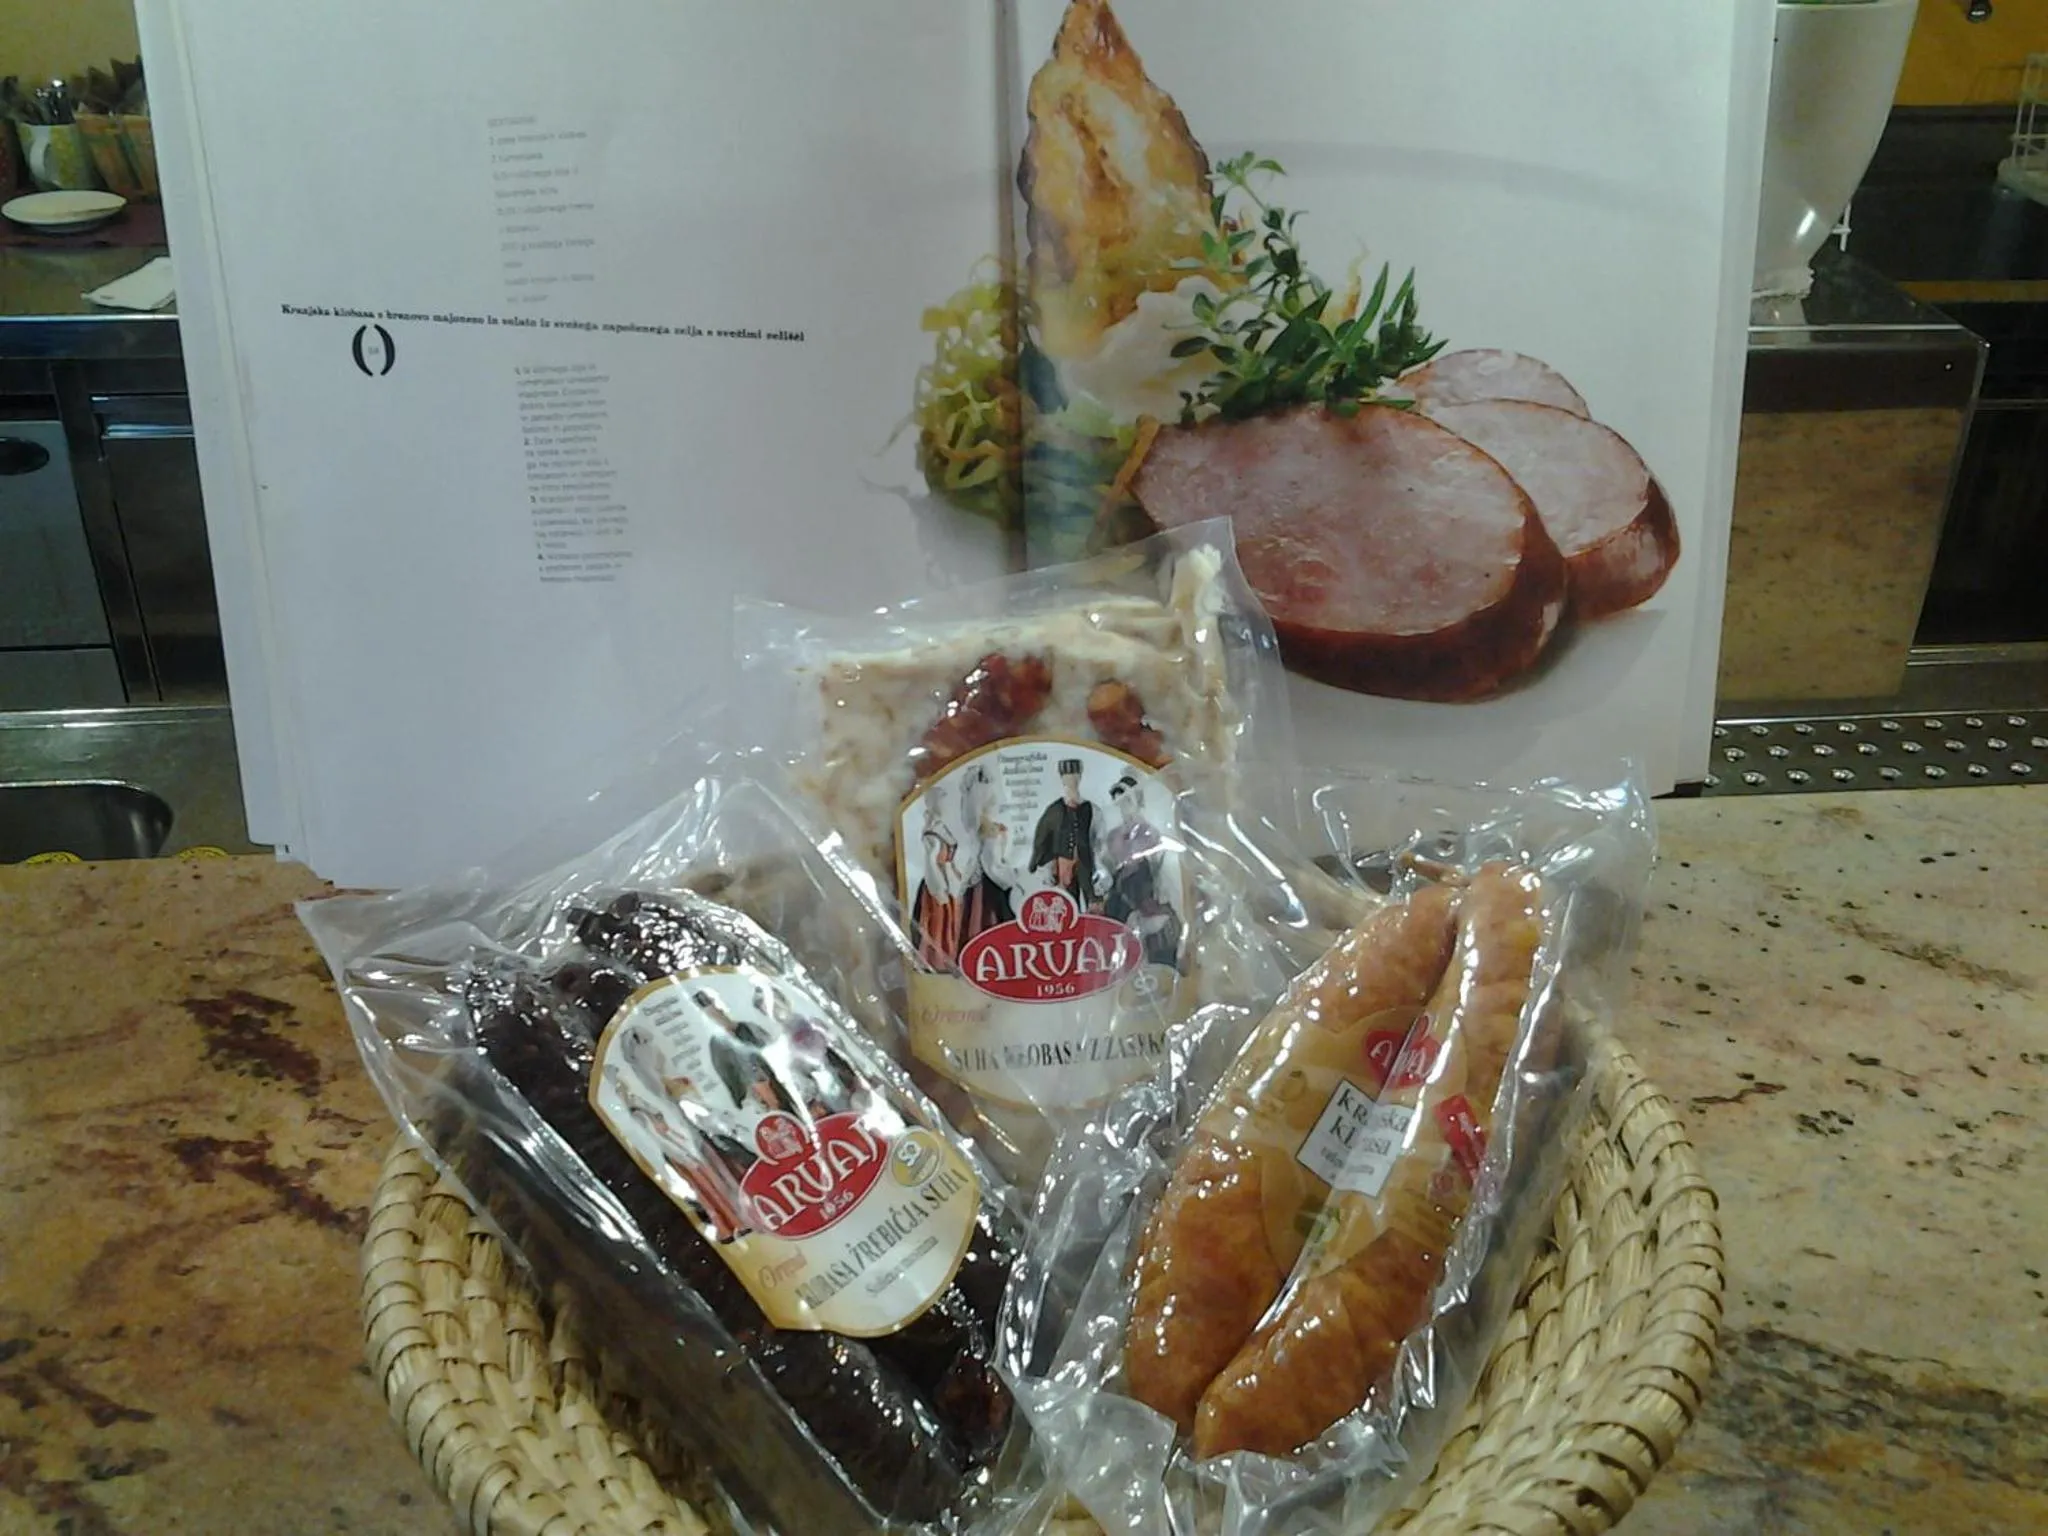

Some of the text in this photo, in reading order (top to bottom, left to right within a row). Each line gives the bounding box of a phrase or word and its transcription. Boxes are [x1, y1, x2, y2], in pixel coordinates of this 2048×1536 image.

[976, 933, 1130, 982] ARVAJ
[1036, 982, 1076, 998] 1956
[752, 1119, 880, 1231] ARVAJ
